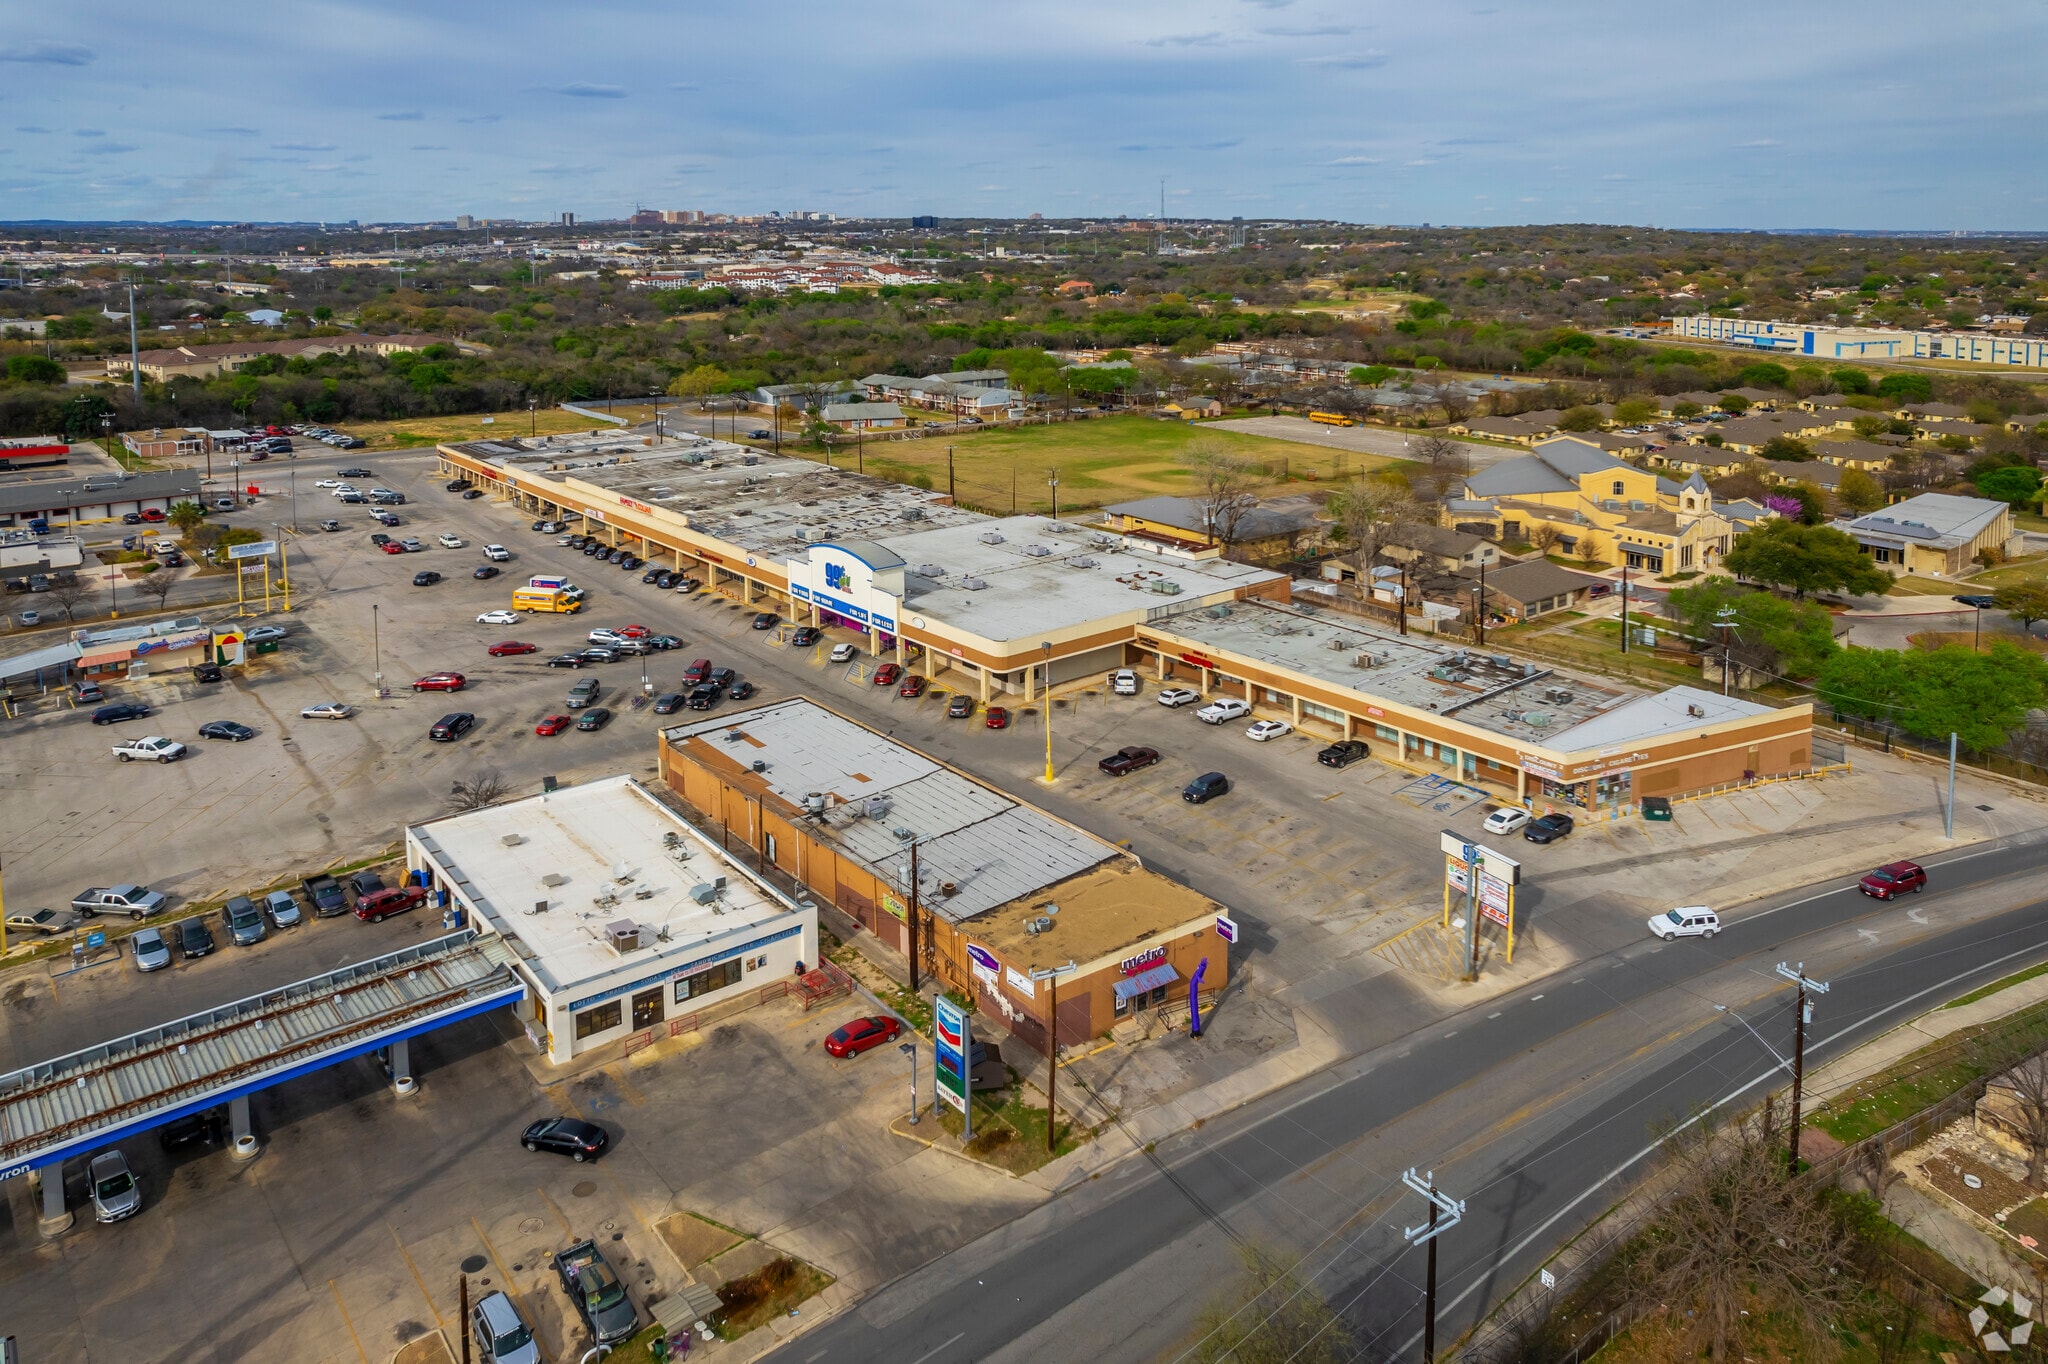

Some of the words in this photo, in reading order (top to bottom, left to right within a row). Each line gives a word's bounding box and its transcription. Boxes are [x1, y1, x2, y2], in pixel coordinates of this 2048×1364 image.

[1449, 857, 1469, 873] LIQUO
[573, 996, 596, 1008] LOTTO
[604, 983, 632, 997] SNACKS
[640, 973, 662, 985] SODAS
[690, 951, 730, 967] SANDWICHES
[739, 942, 755, 952] BEER
[760, 929, 798, 944] CIGARETTES
[1121, 945, 1167, 970] metro
[938, 1003, 961, 1024] Chevron
